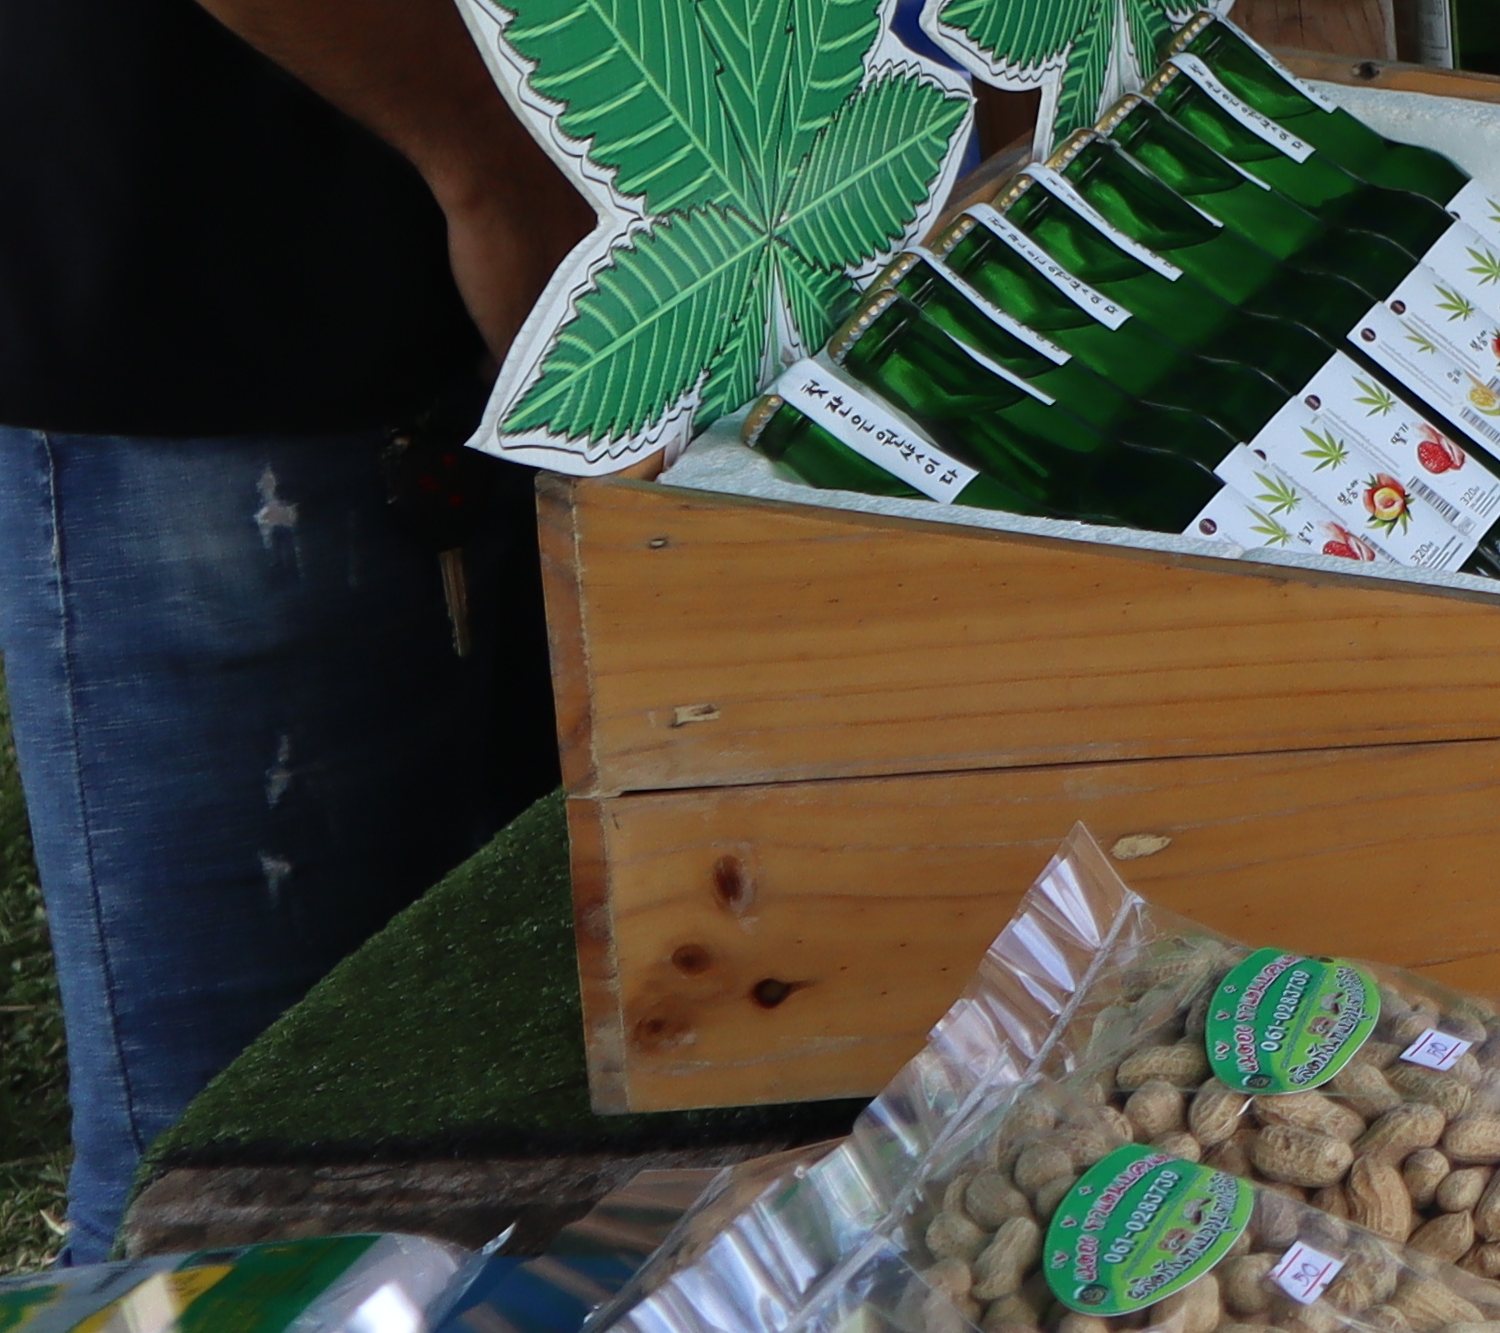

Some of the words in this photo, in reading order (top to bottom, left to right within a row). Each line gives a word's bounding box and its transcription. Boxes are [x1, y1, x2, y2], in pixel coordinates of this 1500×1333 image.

[1260, 969, 1311, 1051] 061-0283739
[1104, 1170, 1183, 1263] 061-0283739
[1292, 1261, 1320, 1287] 50
